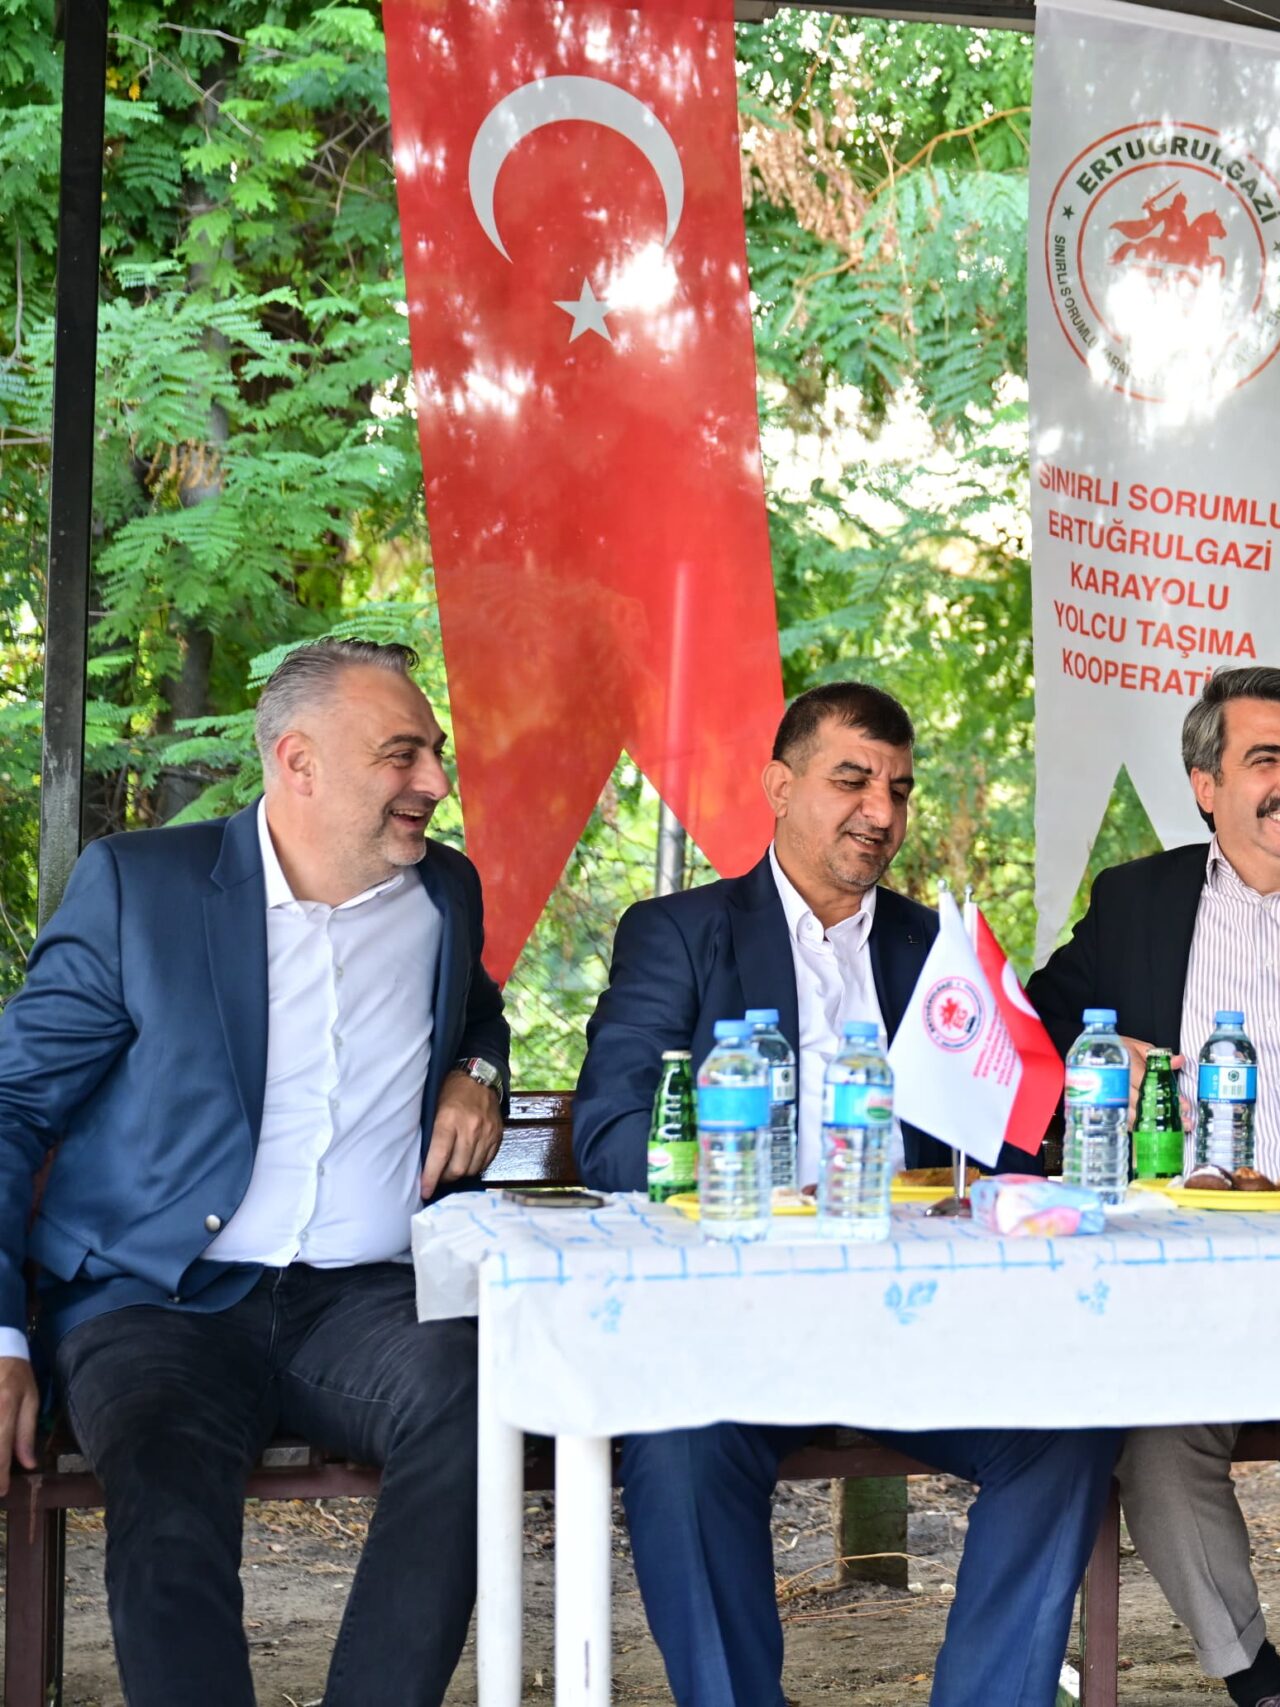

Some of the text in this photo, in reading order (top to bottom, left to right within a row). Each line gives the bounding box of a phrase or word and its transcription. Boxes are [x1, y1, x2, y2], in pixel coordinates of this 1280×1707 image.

[1055, 235, 1067, 284] SINIRLI
[1039, 463, 1118, 507] SINIRLI
[1048, 509, 1272, 571] ERTUĞRULGAZİ
[1070, 561, 1229, 611] KARAYOLU
[1054, 600, 1257, 659] YOLCU TAŞIMA
[1062, 648, 1211, 697] KOOPERATİ
